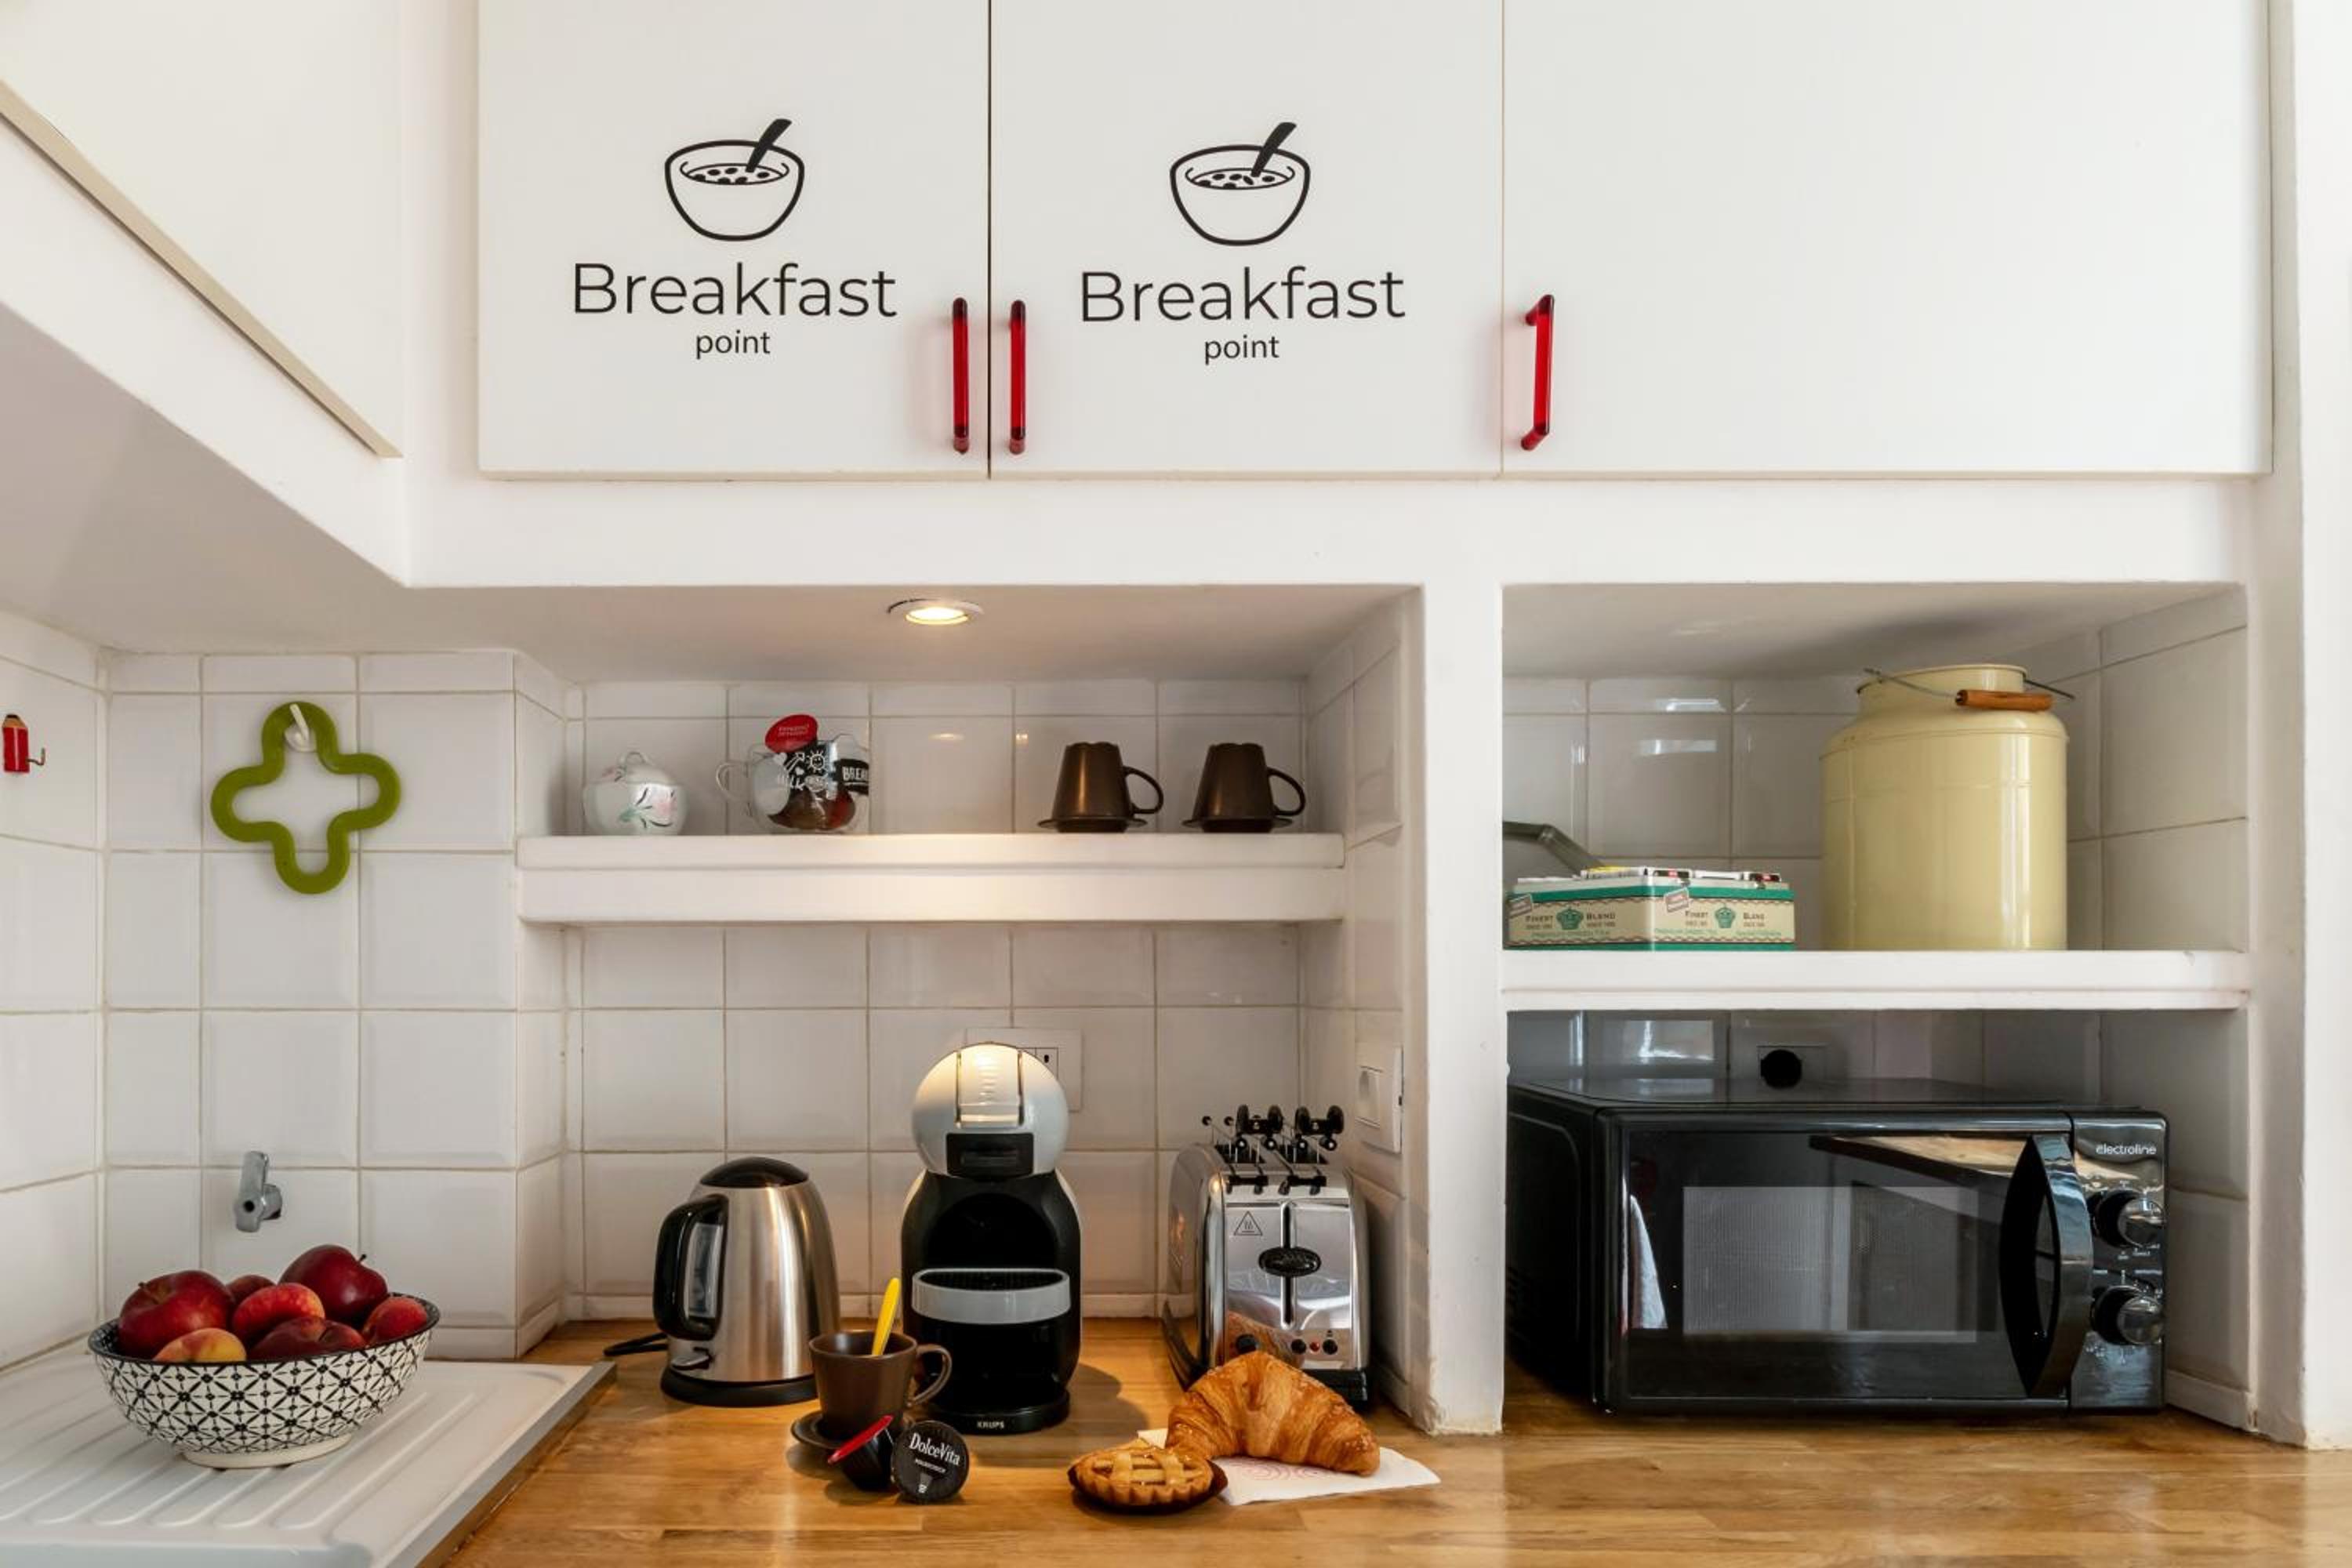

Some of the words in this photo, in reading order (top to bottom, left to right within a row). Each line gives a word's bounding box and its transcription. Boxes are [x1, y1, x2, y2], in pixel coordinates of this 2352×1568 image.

[574, 261, 898, 318] Breakfast
[1081, 265, 1406, 322] Breakfast
[695, 329, 771, 360] point
[1203, 334, 1279, 365] point
[2096, 1143, 2157, 1155] electroline
[977, 1421, 1004, 1429] KRUPS
[909, 1432, 960, 1466] DolceVita
